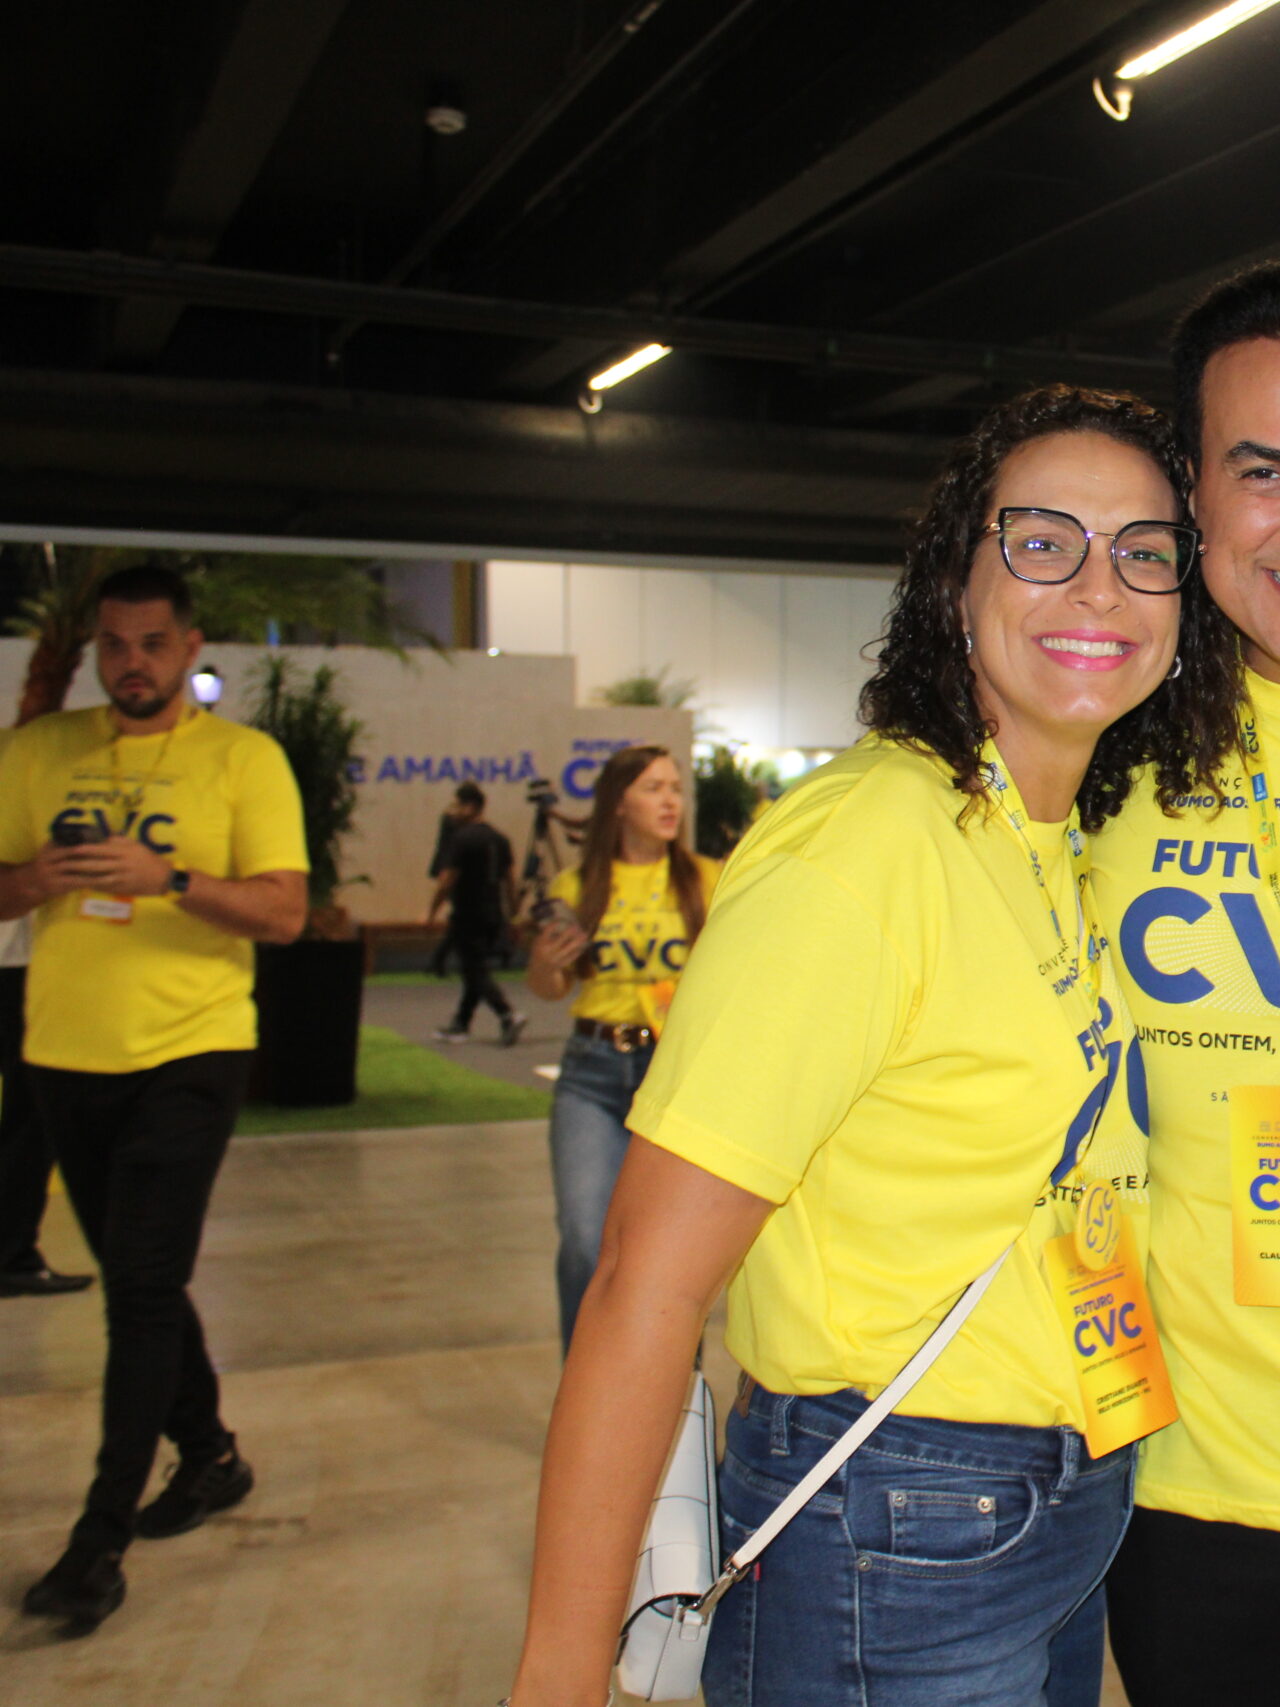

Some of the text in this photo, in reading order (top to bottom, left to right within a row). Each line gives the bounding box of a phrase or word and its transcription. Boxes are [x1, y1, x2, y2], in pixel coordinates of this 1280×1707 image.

[377, 751, 536, 783] AMANHÃ
[1134, 1024, 1193, 1047] UNTOS
[1198, 1032, 1276, 1055] ONTEM,
[1074, 1293, 1115, 1317] FUTURO
[1074, 1302, 1142, 1357] CVC
